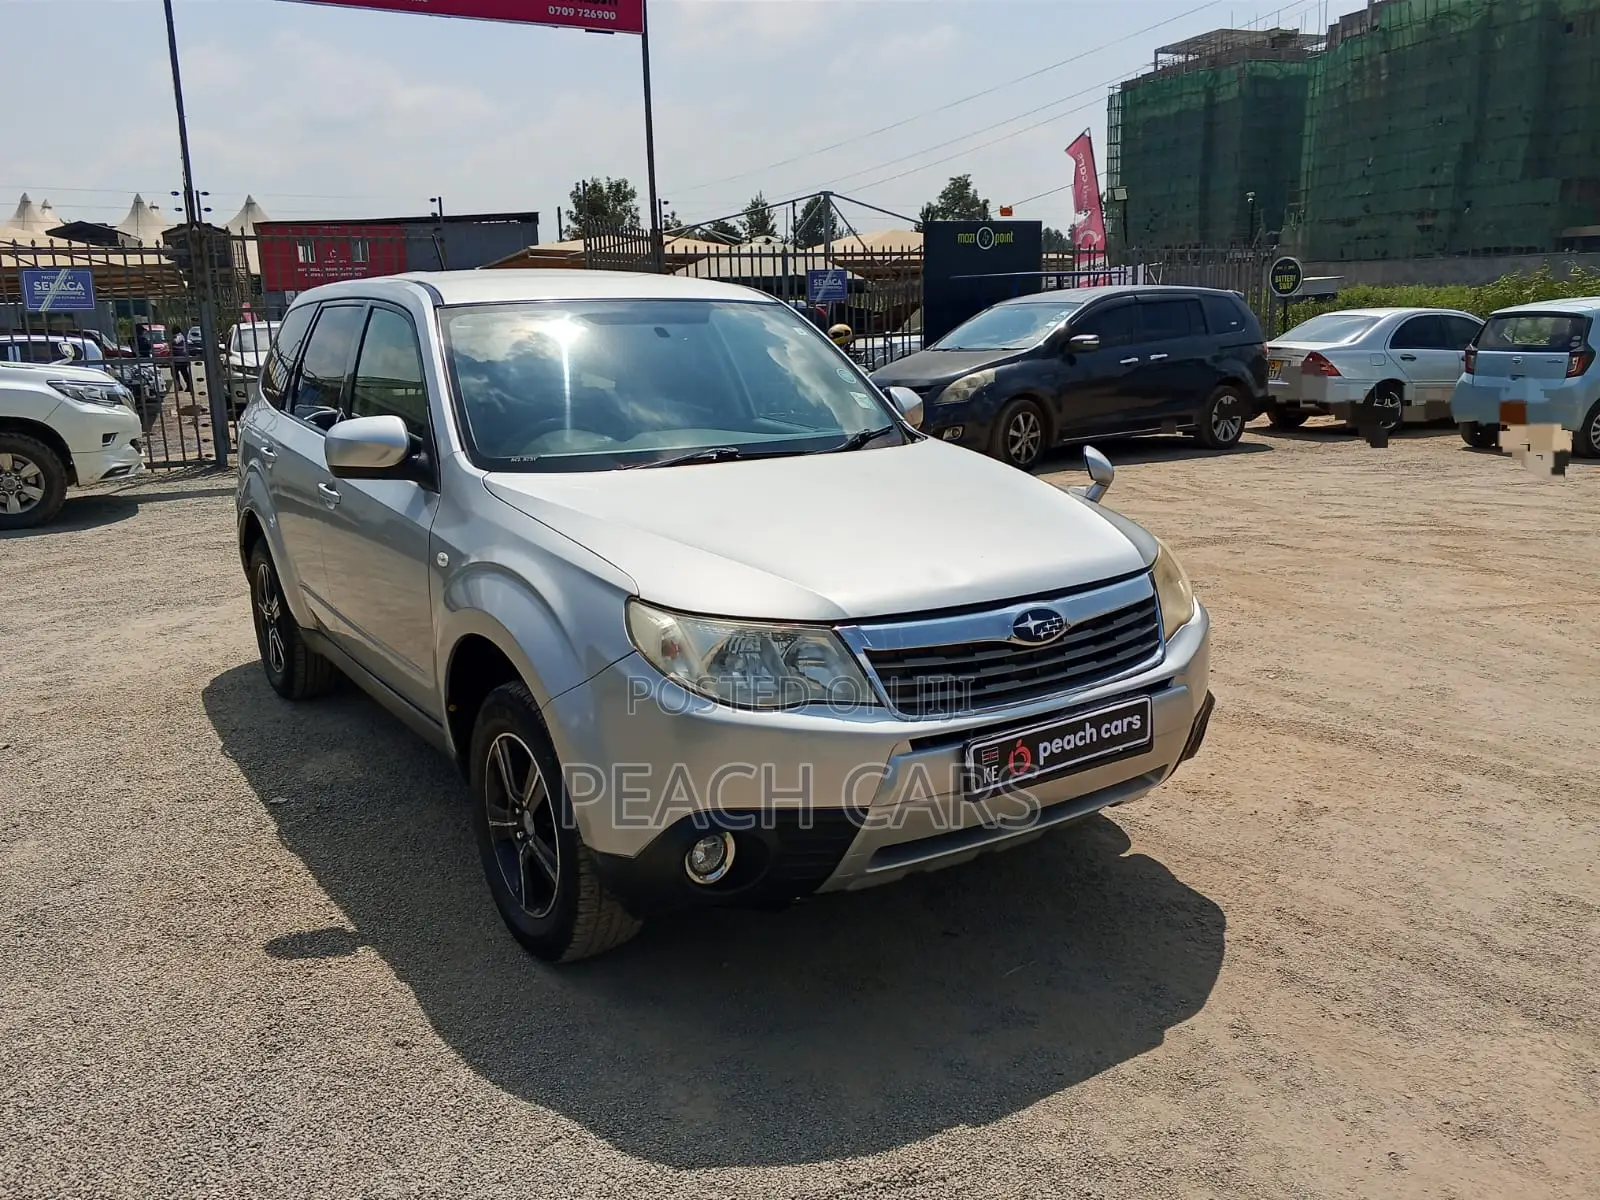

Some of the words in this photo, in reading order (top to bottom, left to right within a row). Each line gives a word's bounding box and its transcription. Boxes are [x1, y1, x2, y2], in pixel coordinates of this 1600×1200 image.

[548, 5, 575, 16] 0709
[577, 9, 617, 20] 726900
[1038, 722, 1097, 766] peach
[1100, 714, 1142, 739] cars
[983, 765, 999, 784] KE
